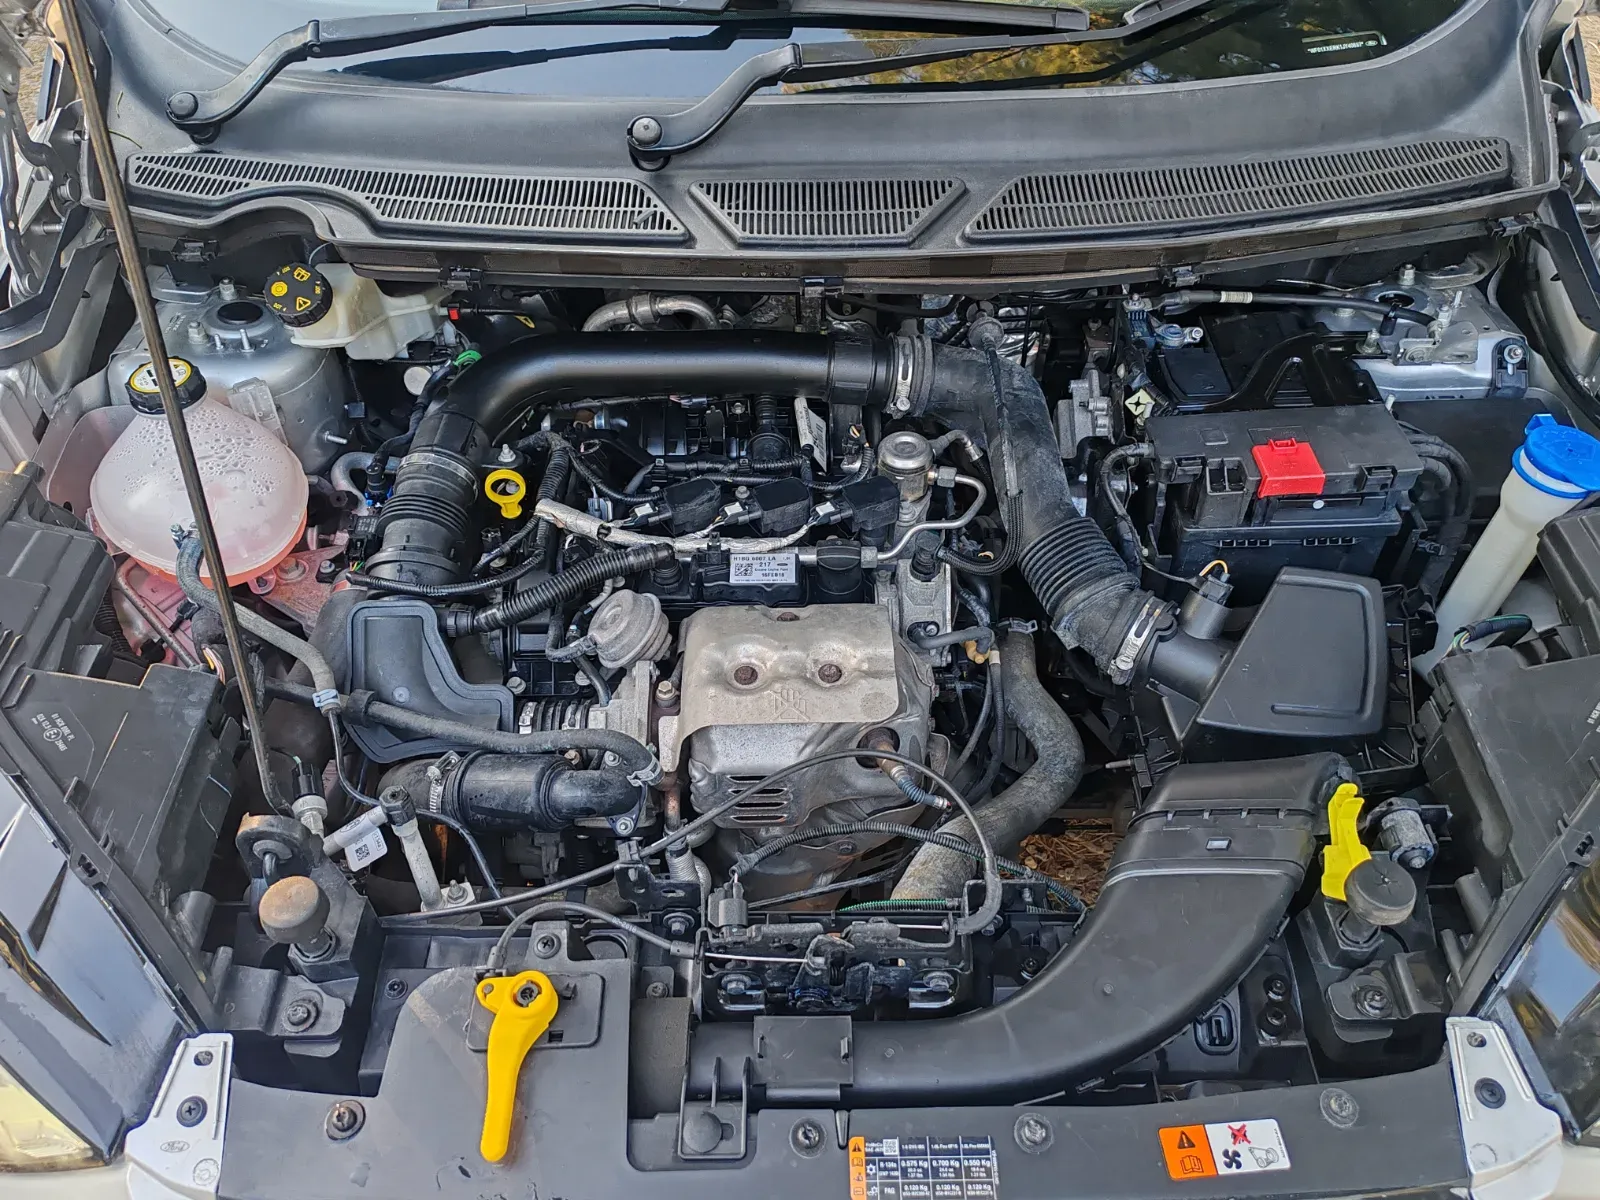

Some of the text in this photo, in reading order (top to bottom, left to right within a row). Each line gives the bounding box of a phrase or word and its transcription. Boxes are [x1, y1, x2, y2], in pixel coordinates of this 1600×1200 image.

[919, 1160, 928, 1168] Kg
[950, 1160, 960, 1168] Kg
[982, 1159, 990, 1167] Kg
